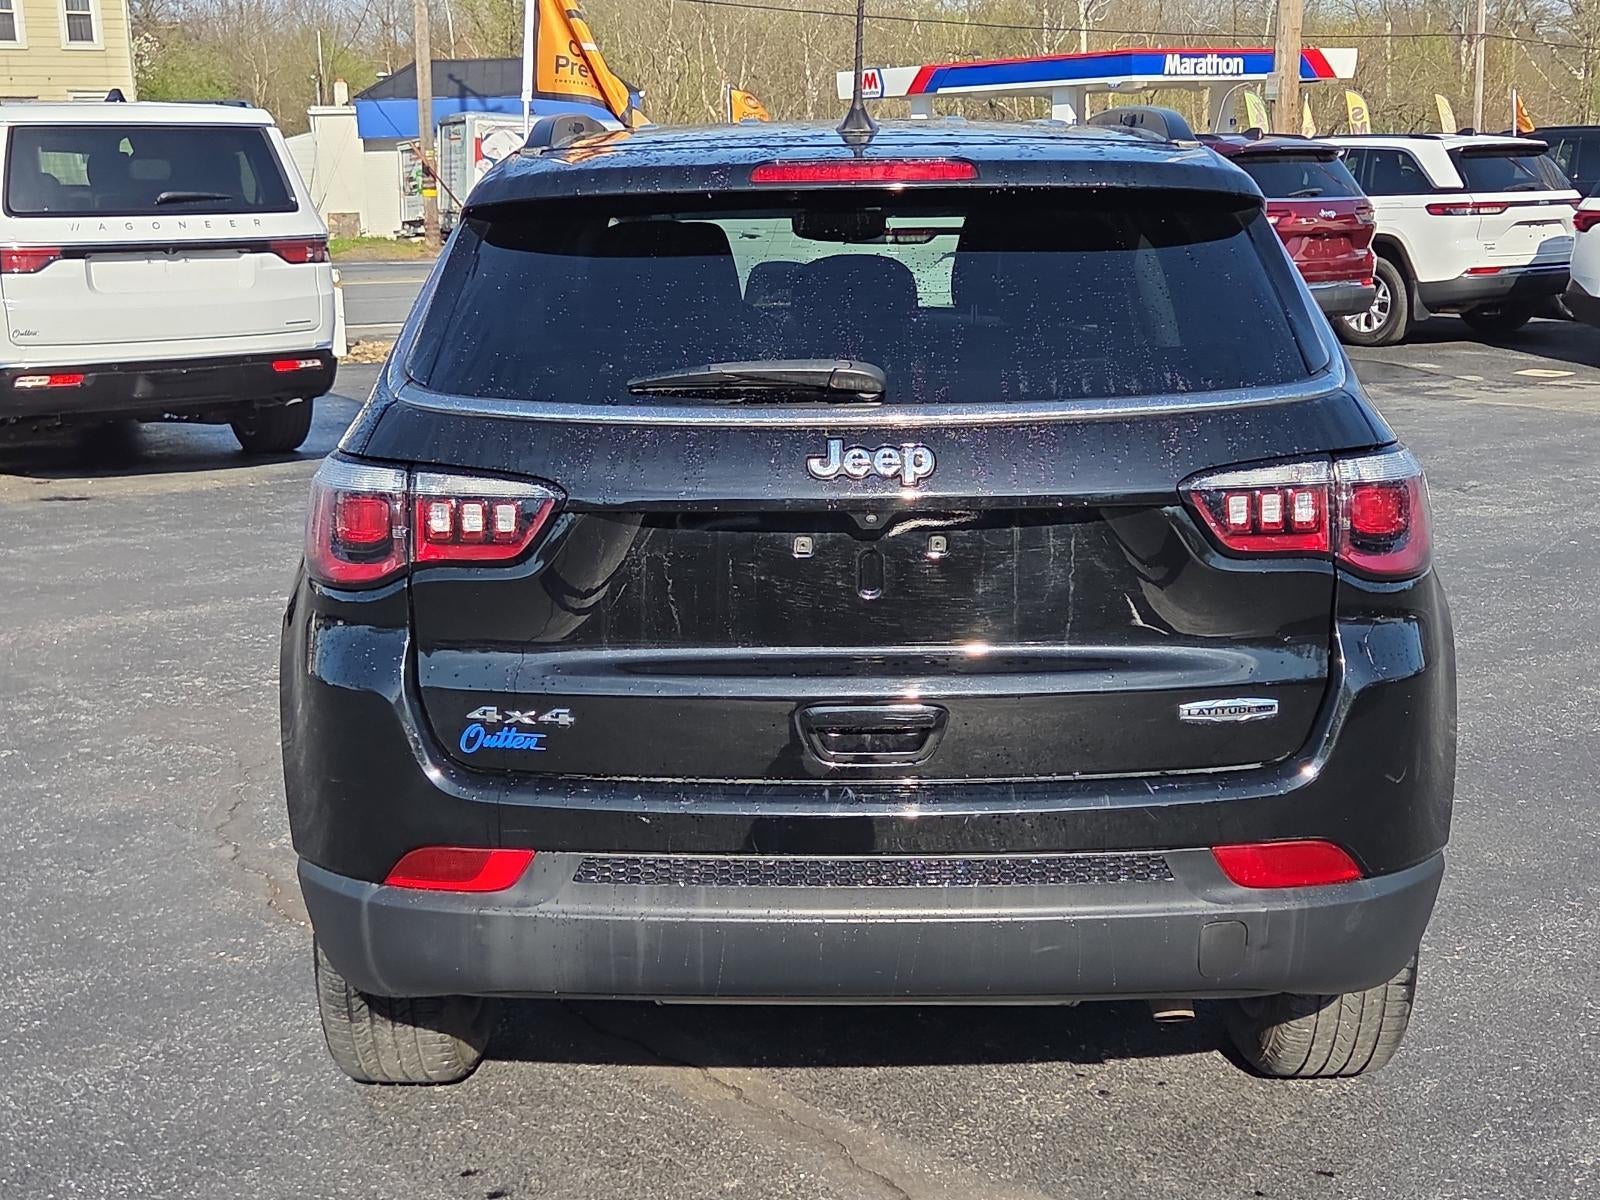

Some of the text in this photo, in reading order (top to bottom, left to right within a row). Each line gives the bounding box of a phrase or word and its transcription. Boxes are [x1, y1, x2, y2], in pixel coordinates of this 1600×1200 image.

[1163, 54, 1244, 75] Marathon
[807, 438, 936, 486] Jeep
[460, 723, 548, 753] Outten
